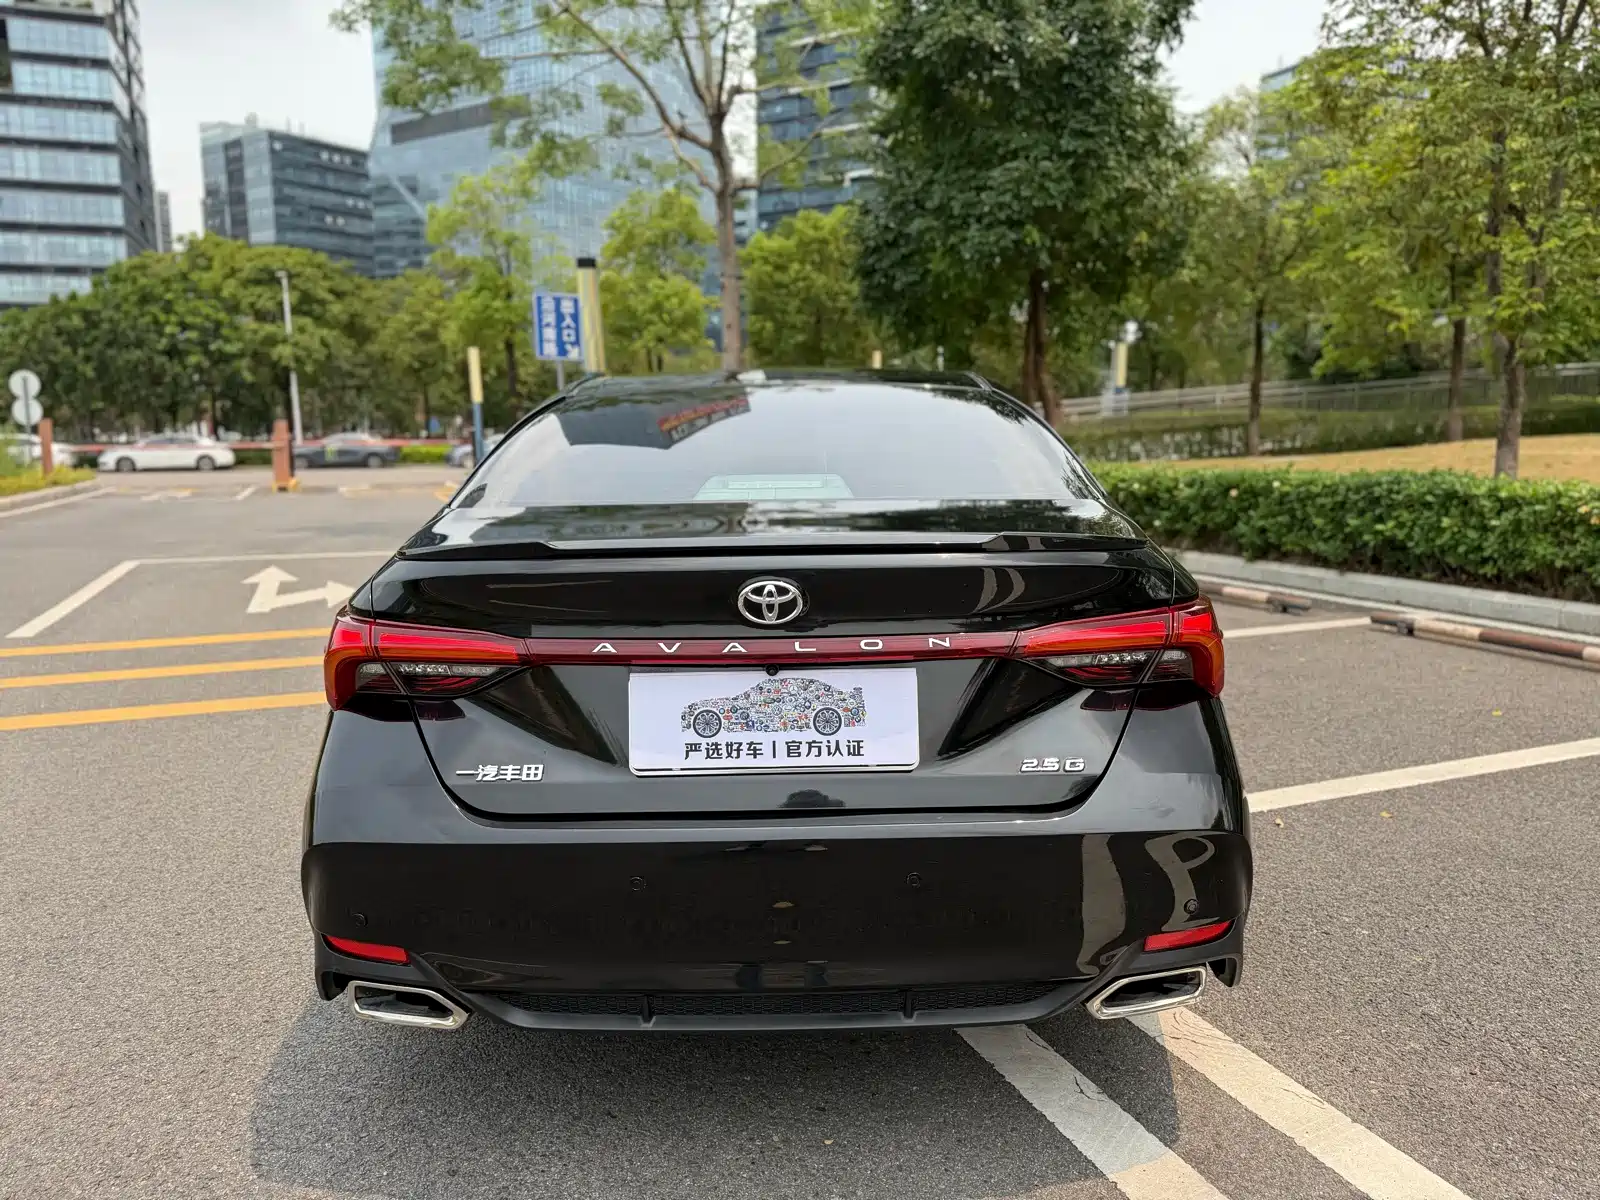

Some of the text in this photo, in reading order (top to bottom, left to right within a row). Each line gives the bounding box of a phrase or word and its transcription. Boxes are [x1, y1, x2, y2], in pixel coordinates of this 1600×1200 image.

[592, 637, 951, 654] AVALON
[455, 764, 544, 781] 一汽丰田
